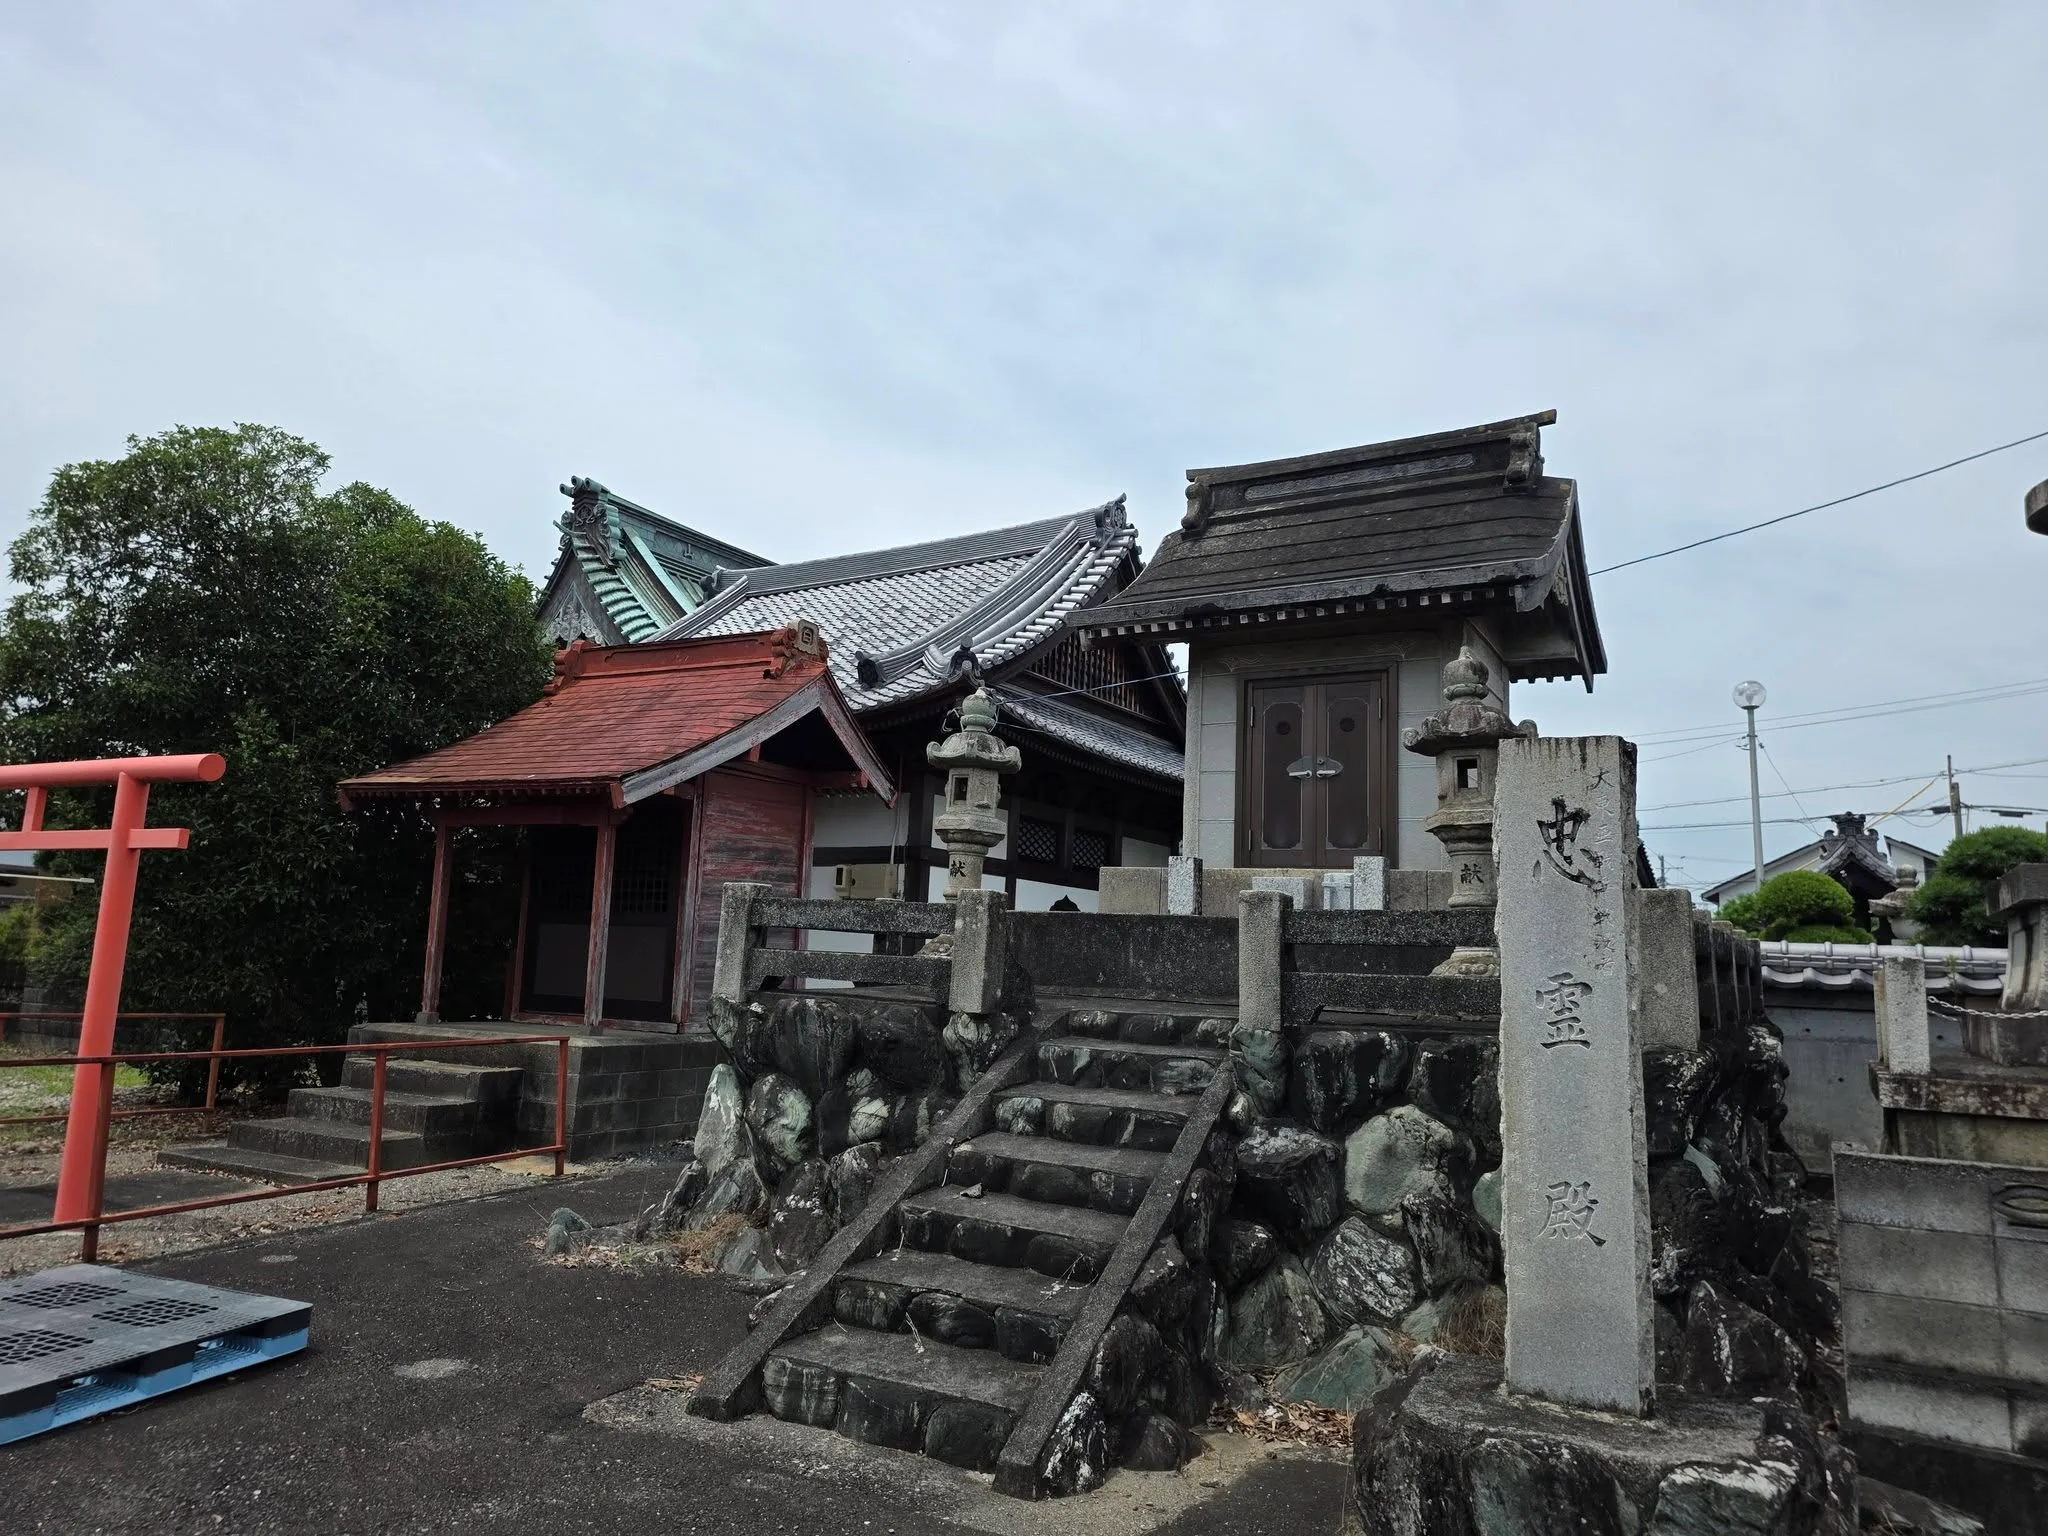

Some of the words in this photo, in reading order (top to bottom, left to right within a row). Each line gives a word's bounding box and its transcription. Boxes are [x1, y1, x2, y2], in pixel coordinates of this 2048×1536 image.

[950, 860, 966, 877] 献
[1461, 863, 1484, 884] 献
[1533, 796, 1607, 1247] 忠霊殿
